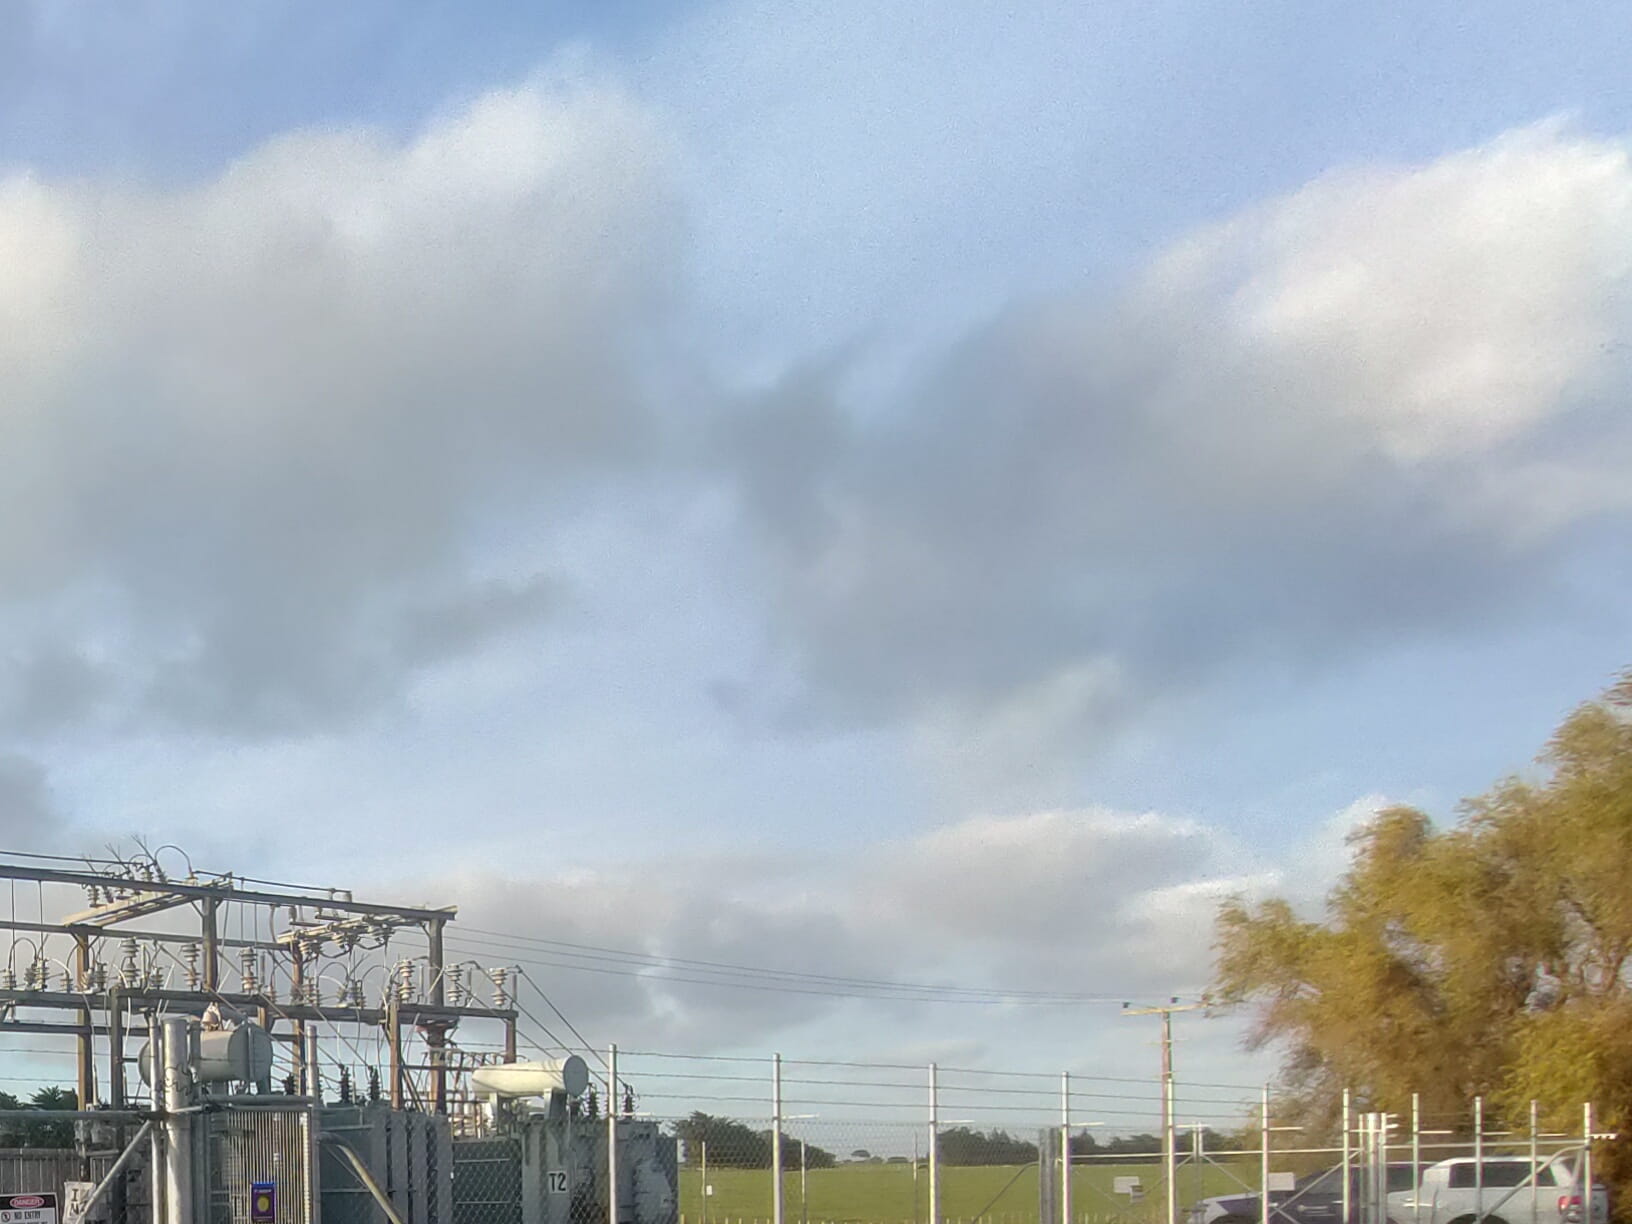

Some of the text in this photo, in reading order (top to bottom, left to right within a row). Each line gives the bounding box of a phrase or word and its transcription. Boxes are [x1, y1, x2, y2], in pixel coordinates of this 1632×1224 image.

[549, 1172, 566, 1192] T2
[14, 1210, 41, 1220] NO ENTRY
